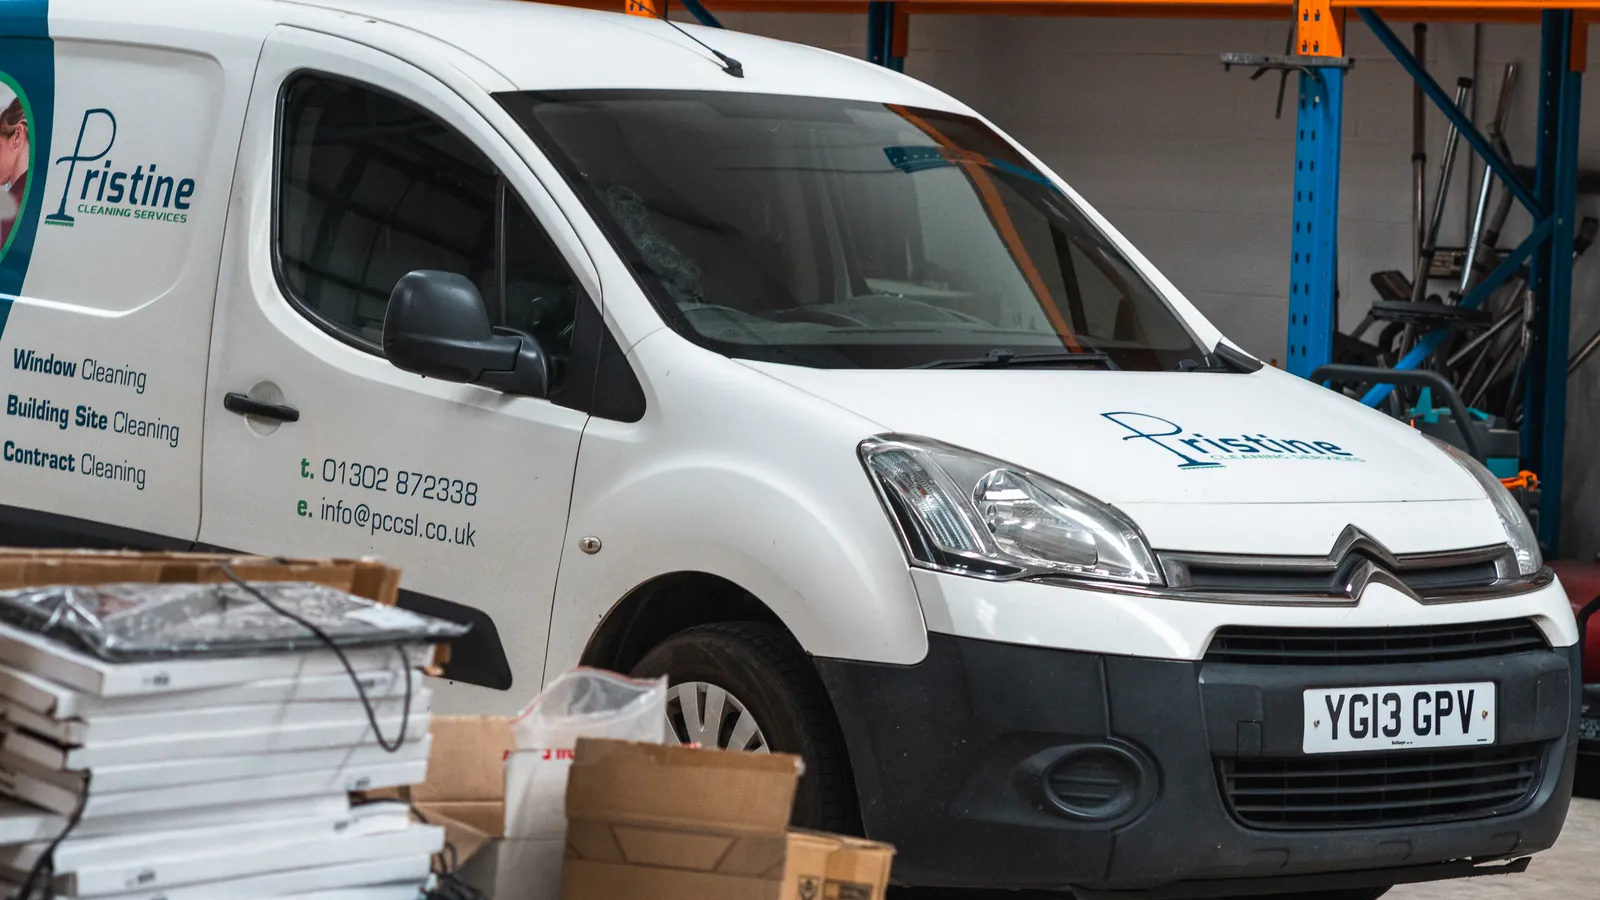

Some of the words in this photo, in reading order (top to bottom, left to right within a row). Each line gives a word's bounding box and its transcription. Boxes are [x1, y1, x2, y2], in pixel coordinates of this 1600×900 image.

[44, 108, 196, 227] Pristine
[77, 203, 132, 218] CLEANING
[133, 209, 188, 224] SERVICES
[13, 348, 77, 377] Window
[81, 358, 147, 394] Cleaning
[6, 394, 69, 430] Building
[75, 405, 108, 430] Site
[113, 411, 180, 448] Cleaning
[1099, 411, 1353, 470] Pristine
[3, 440, 76, 472] Contract
[81, 453, 146, 490] Cleaning
[300, 458, 314, 479] t.
[322, 458, 389, 492] 01302
[395, 470, 478, 506] 872338
[296, 499, 313, 517] e.
[320, 496, 476, 547] info@pccsl.co.uk
[1324, 692, 1402, 740] YG13
[1412, 689, 1475, 736] GPV
